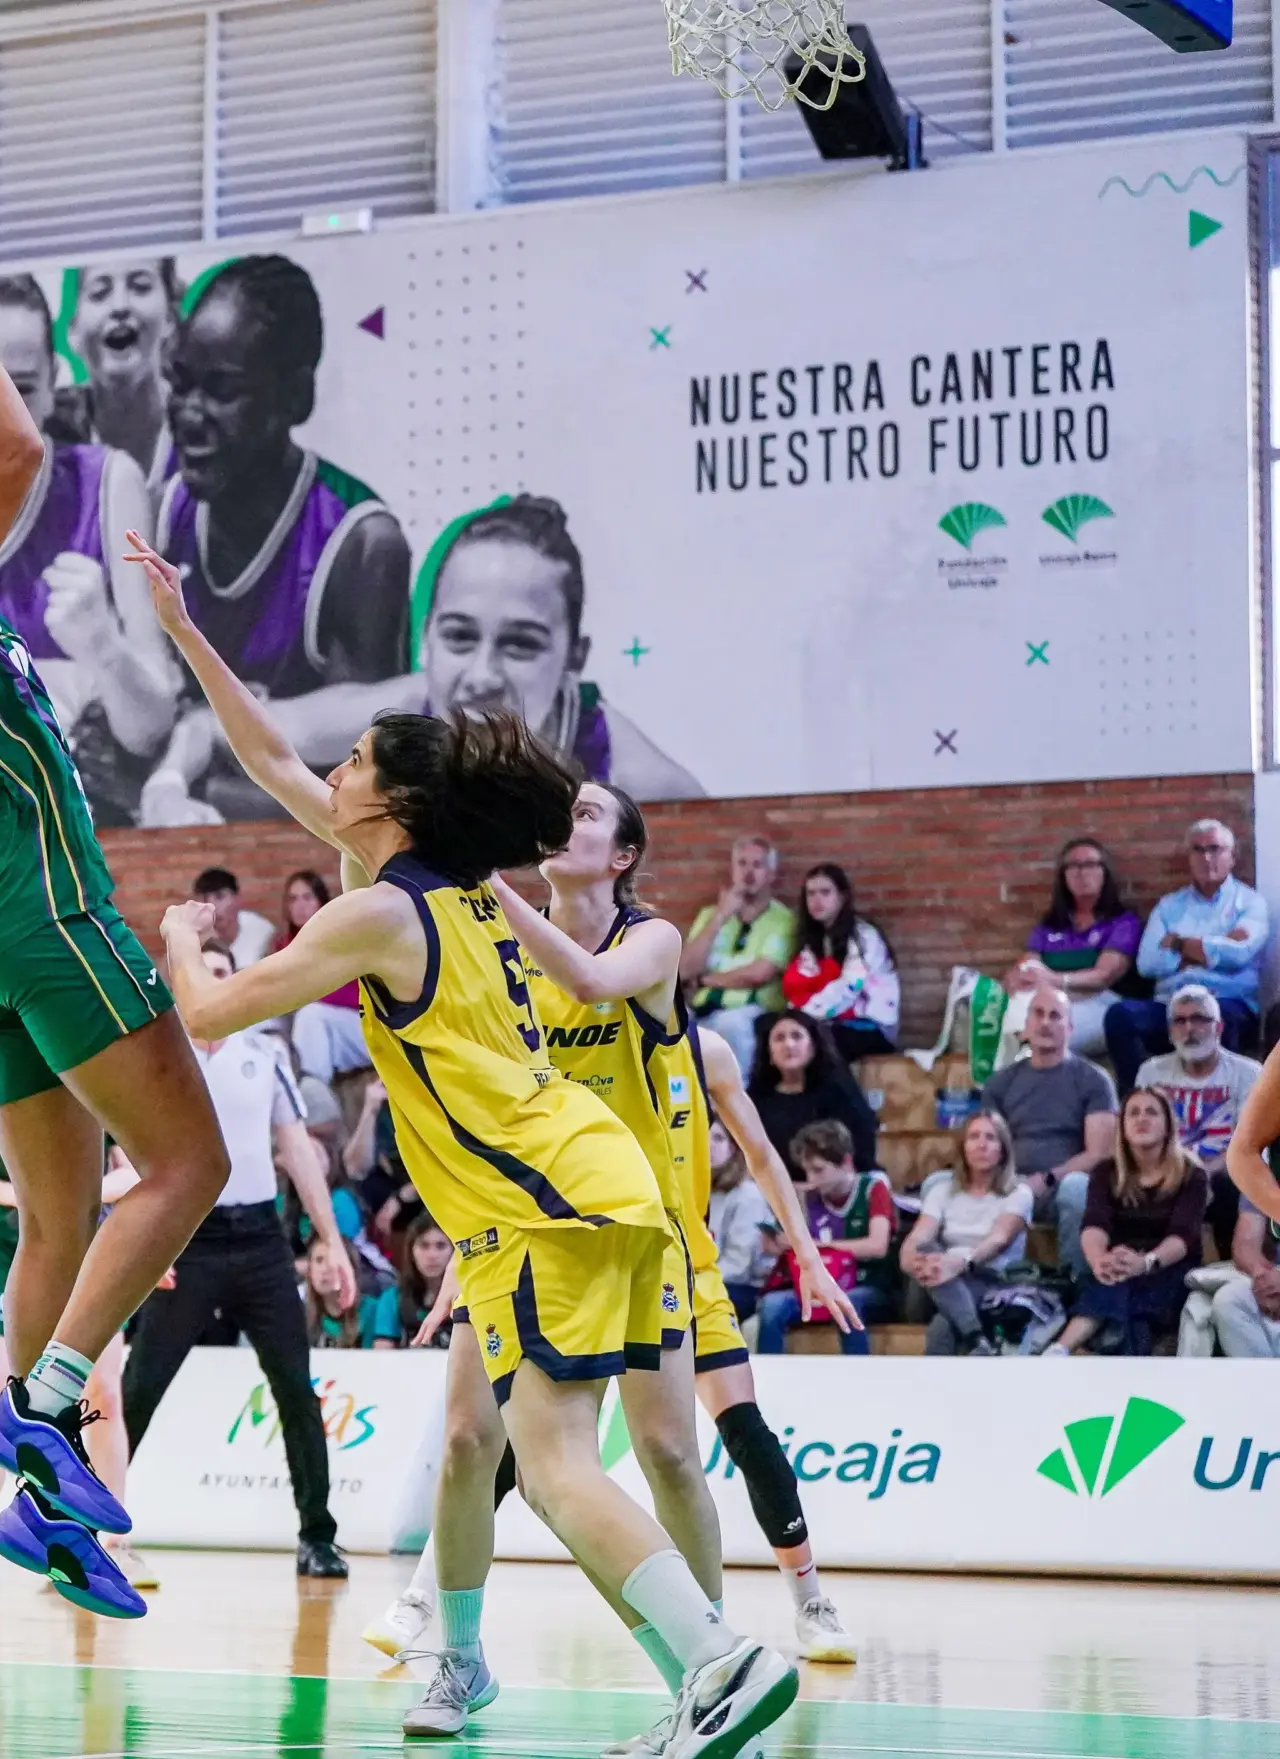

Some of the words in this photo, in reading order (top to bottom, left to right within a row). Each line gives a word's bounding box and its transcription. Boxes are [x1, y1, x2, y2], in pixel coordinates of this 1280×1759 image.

[690, 359, 886, 426] NUESTRA
[910, 338, 1116, 408] CANTERA
[696, 421, 900, 494] NUESTRO
[929, 403, 1109, 475] FUTURO
[543, 1021, 623, 1048] NOE
